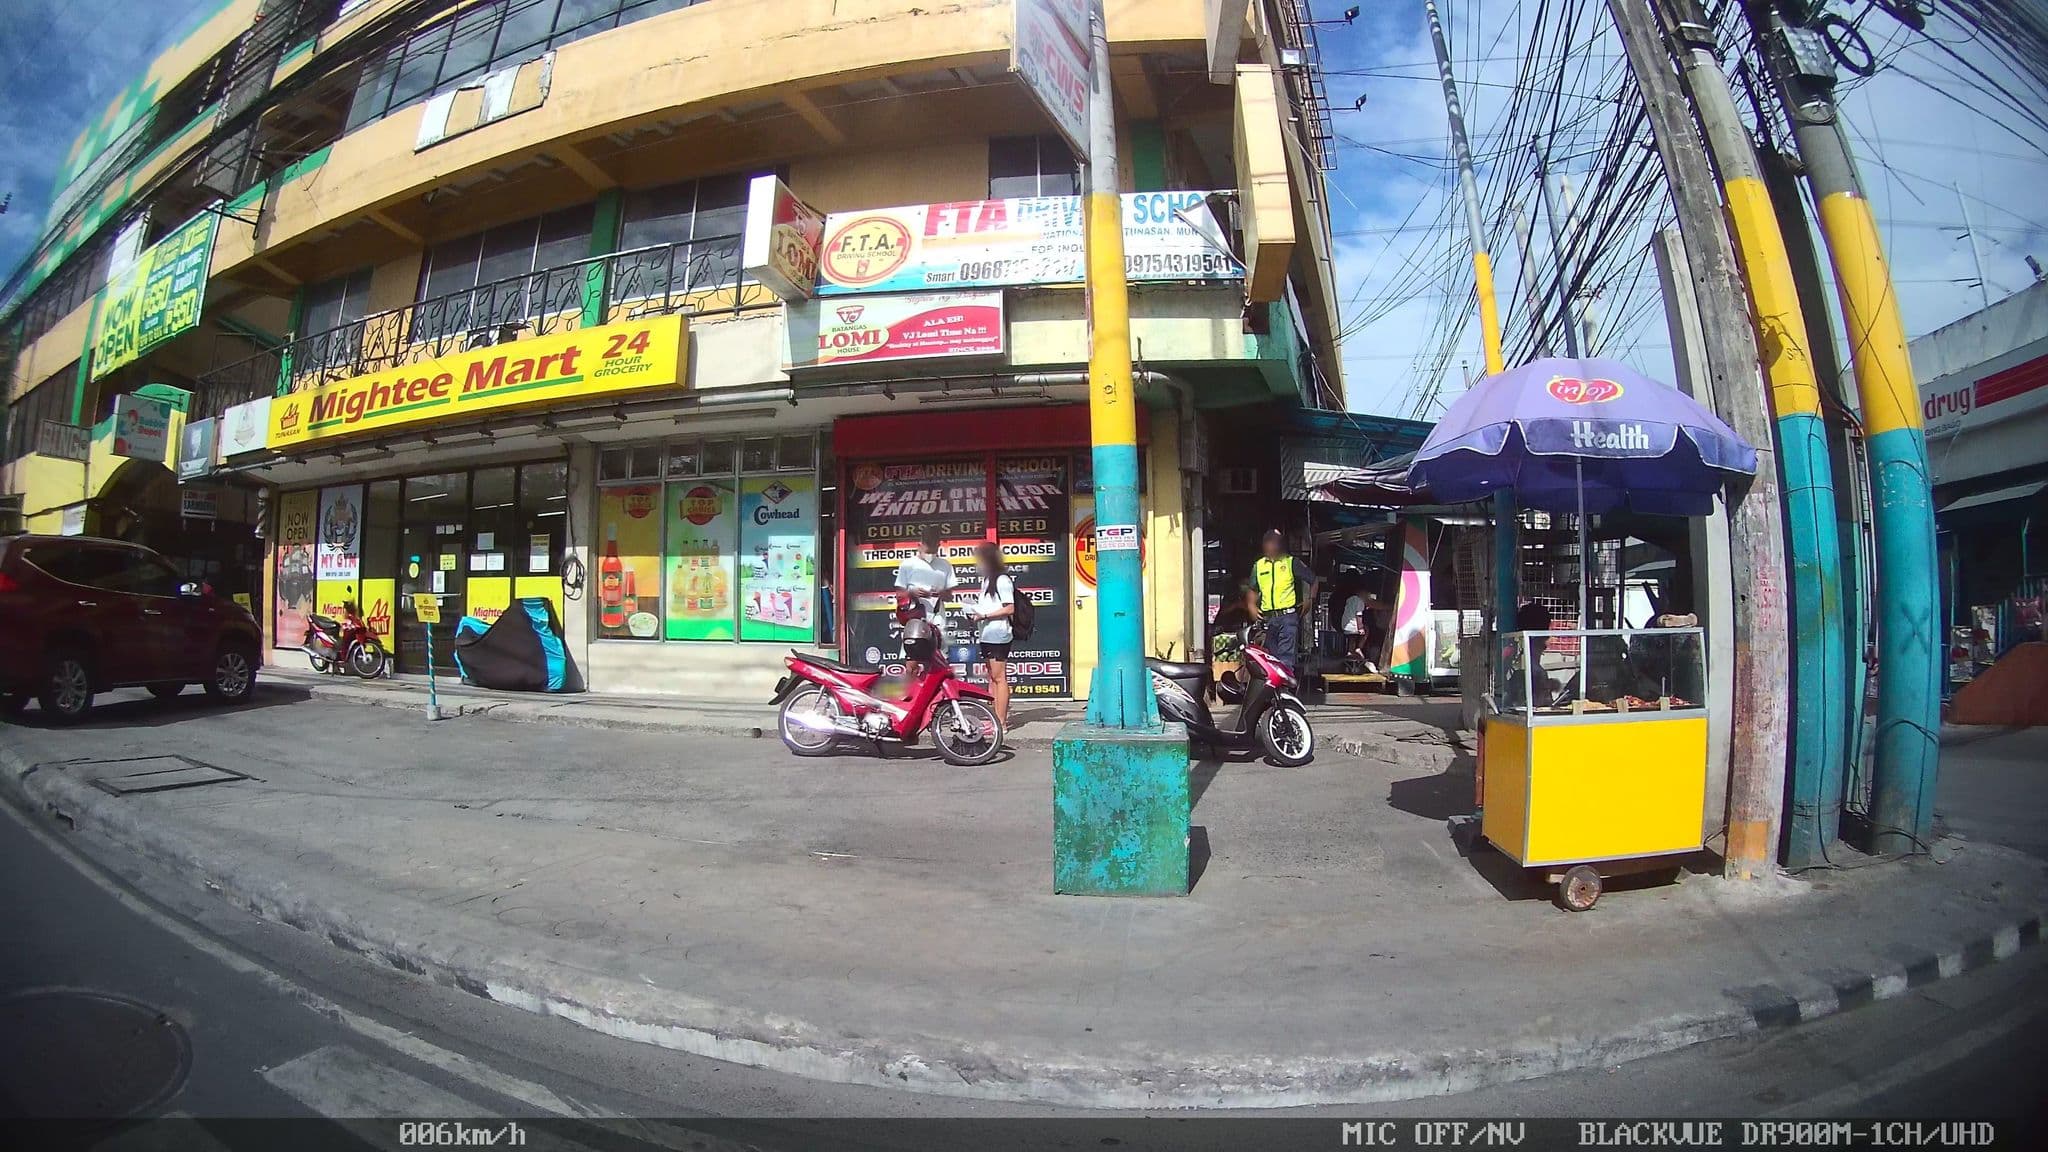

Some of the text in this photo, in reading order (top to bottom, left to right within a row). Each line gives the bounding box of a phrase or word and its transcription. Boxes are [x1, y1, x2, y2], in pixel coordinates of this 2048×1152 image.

[924, 198, 1008, 236] FTA
[840, 233, 895, 252] F.T.A.
[867, 250, 897, 258] SCHOOL
[926, 271, 955, 283] Smart
[831, 324, 867, 333] BATANGAS
[95, 319, 135, 369] OPEN
[602, 330, 651, 358] 24
[818, 328, 881, 350] LOMI
[837, 346, 860, 355] HOUSE
[594, 362, 653, 377] GROCERY
[605, 355, 642, 368] HOUR
[308, 345, 582, 424] Mightee Mart
[1923, 387, 1970, 420] drug
[1570, 420, 1650, 450] Health
[859, 491, 895, 504] WE
[898, 489, 943, 502] ARE
[1013, 484, 1063, 496] FOR
[287, 512, 309, 526] NOW
[753, 505, 800, 525] Cowhead
[286, 528, 308, 541] OPEN
[867, 519, 1047, 538] COURS OFERED
[1096, 528, 1133, 536] TGP
[320, 552, 357, 569] MY GYM
[864, 548, 948, 561] THEORETL
[1003, 543, 1055, 555] COURSE
[473, 607, 502, 620] Mighte
[1008, 650, 1060, 658] ACCREDITED
[1015, 685, 1060, 694] 431 9541
